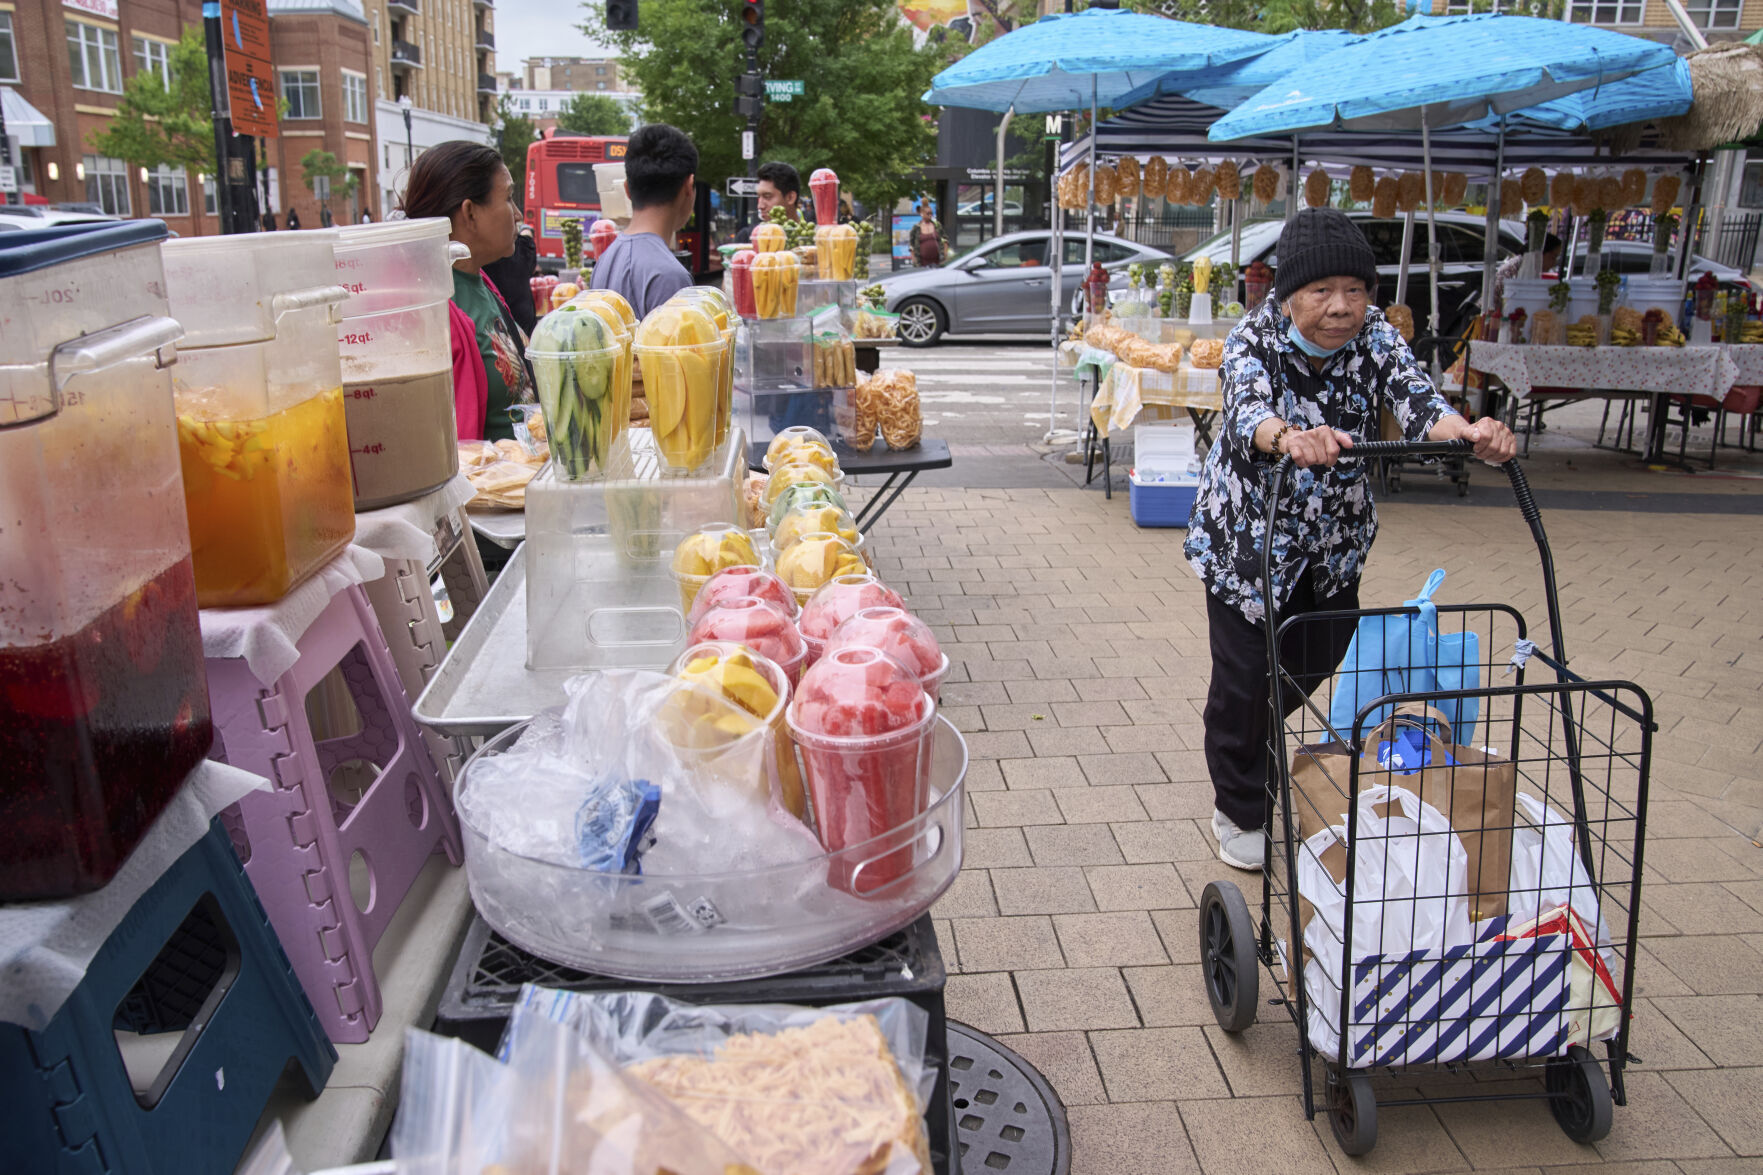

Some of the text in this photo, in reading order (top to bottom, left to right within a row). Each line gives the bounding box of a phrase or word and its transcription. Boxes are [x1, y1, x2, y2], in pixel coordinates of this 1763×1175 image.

[229, 69, 273, 92] ADVERENCIA
[764, 82, 793, 92] RVING
[1045, 114, 1062, 134] M
